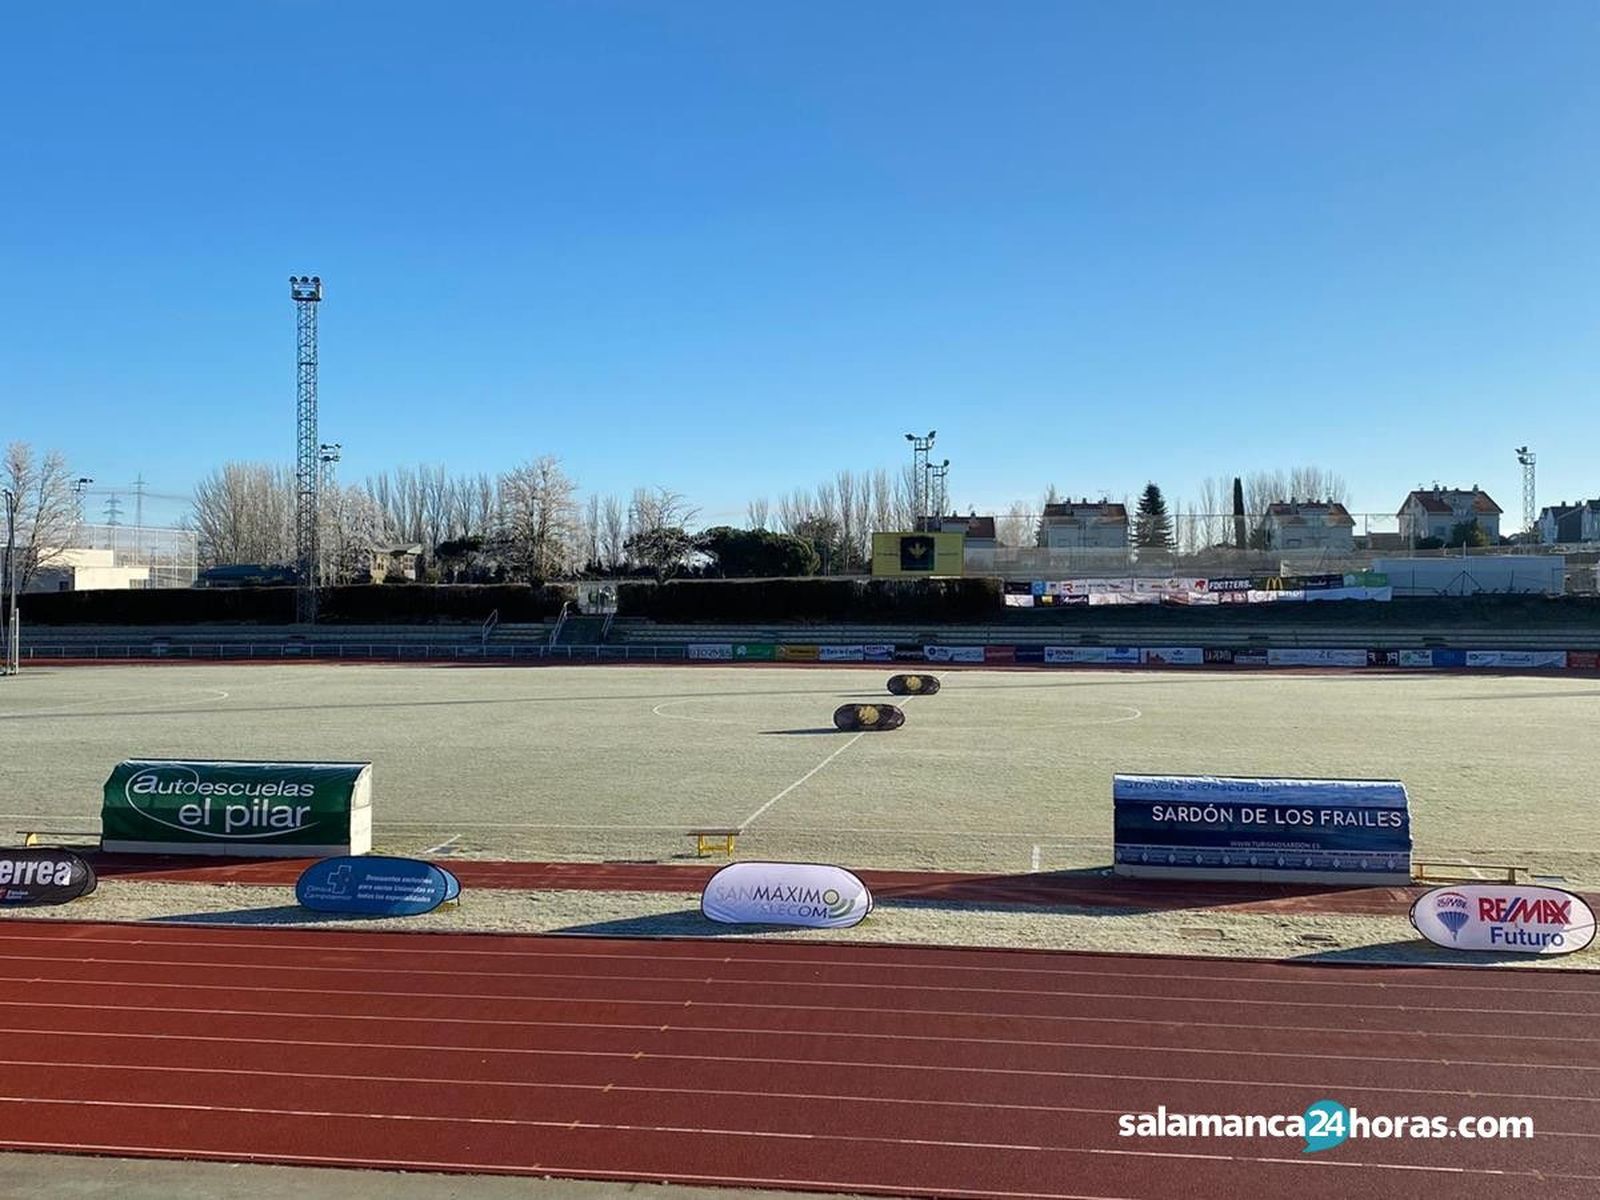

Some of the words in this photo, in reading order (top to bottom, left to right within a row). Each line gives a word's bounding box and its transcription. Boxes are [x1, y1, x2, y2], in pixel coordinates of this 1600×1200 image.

[132, 775, 315, 797] autoescuelas
[178, 798, 211, 826] el
[225, 798, 311, 833] pilar
[1151, 804, 1234, 823] SARDÓN
[1241, 808, 1267, 824] DE
[1275, 808, 1314, 825] LOS
[1320, 810, 1402, 828] FRAILES
[1478, 897, 1573, 925] RE/MAX
[1490, 926, 1565, 947] Futuro
